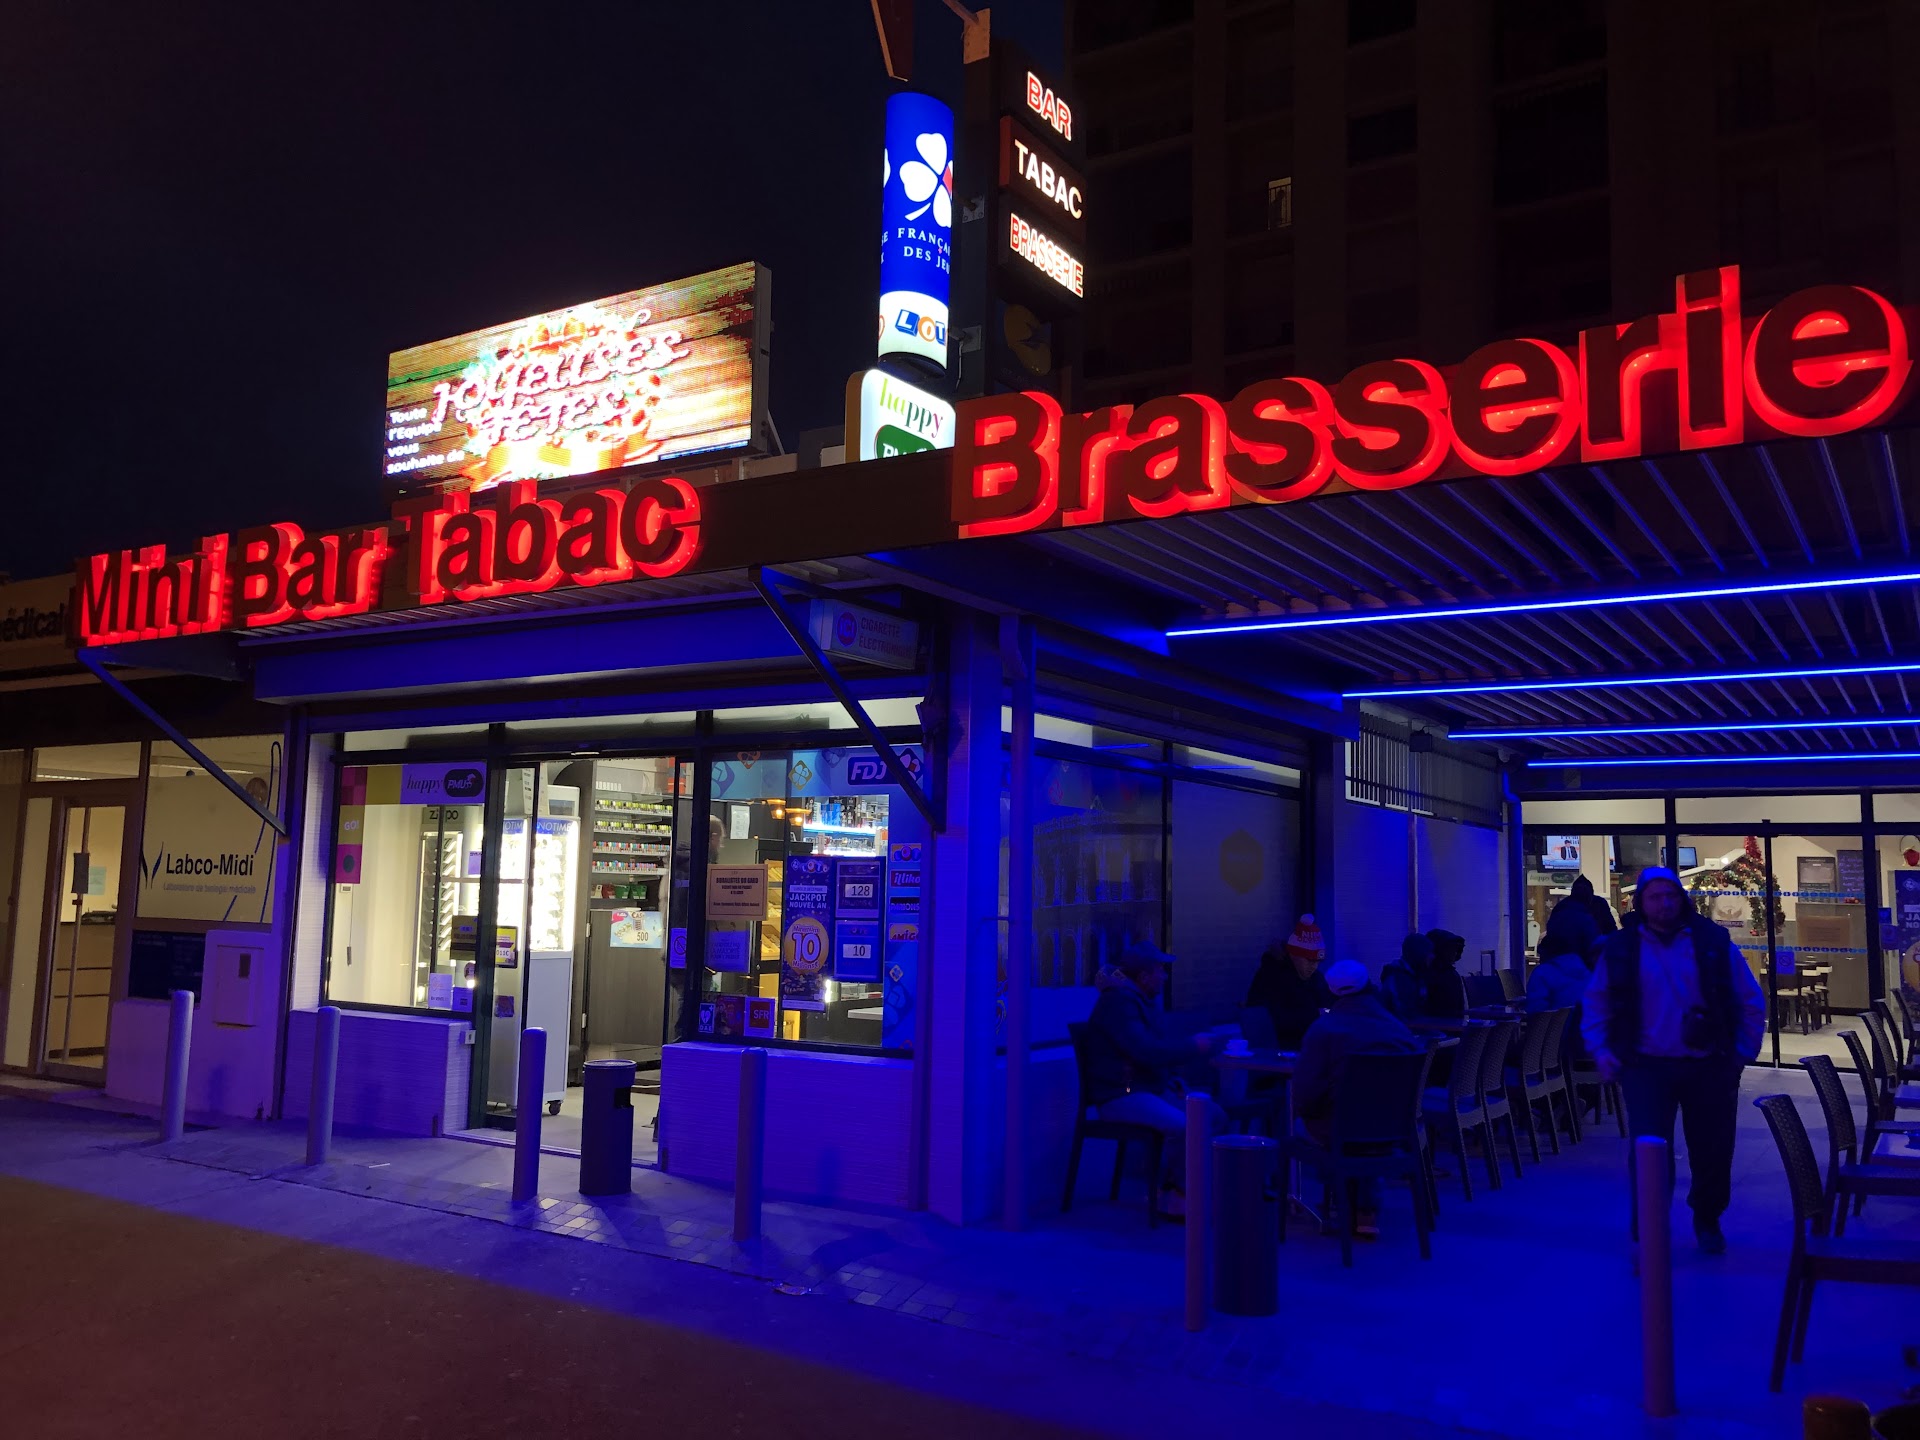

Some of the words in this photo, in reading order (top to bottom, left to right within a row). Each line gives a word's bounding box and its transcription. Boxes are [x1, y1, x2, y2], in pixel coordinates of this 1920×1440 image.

[1027, 71, 1072, 141] BAR
[1014, 139, 1082, 219] TABAC
[903, 245, 931, 262] DES
[1010, 213, 1084, 299] BRASSERIE
[895, 309, 948, 347] LOT
[880, 378, 944, 439] happy
[950, 264, 1912, 540] Brasserie
[390, 408, 427, 424] Toute
[387, 443, 419, 457] vous
[387, 454, 445, 474] souhaite
[76, 532, 230, 647] Mini
[232, 522, 389, 628] Bar
[391, 477, 702, 606] Tabac
[861, 617, 901, 639] CIGARETTE
[851, 761, 888, 780] FDJ
[407, 774, 441, 795] happy
[429, 808, 459, 823] Zipo
[166, 853, 255, 876] Labco-Midi
[790, 893, 827, 902] JACKPOT
[851, 885, 871, 897] 128
[789, 901, 816, 909] NOUVEL
[636, 931, 649, 942] 500
[792, 932, 822, 963] 10
[852, 945, 867, 957] 10
[753, 1009, 770, 1020] SFR
